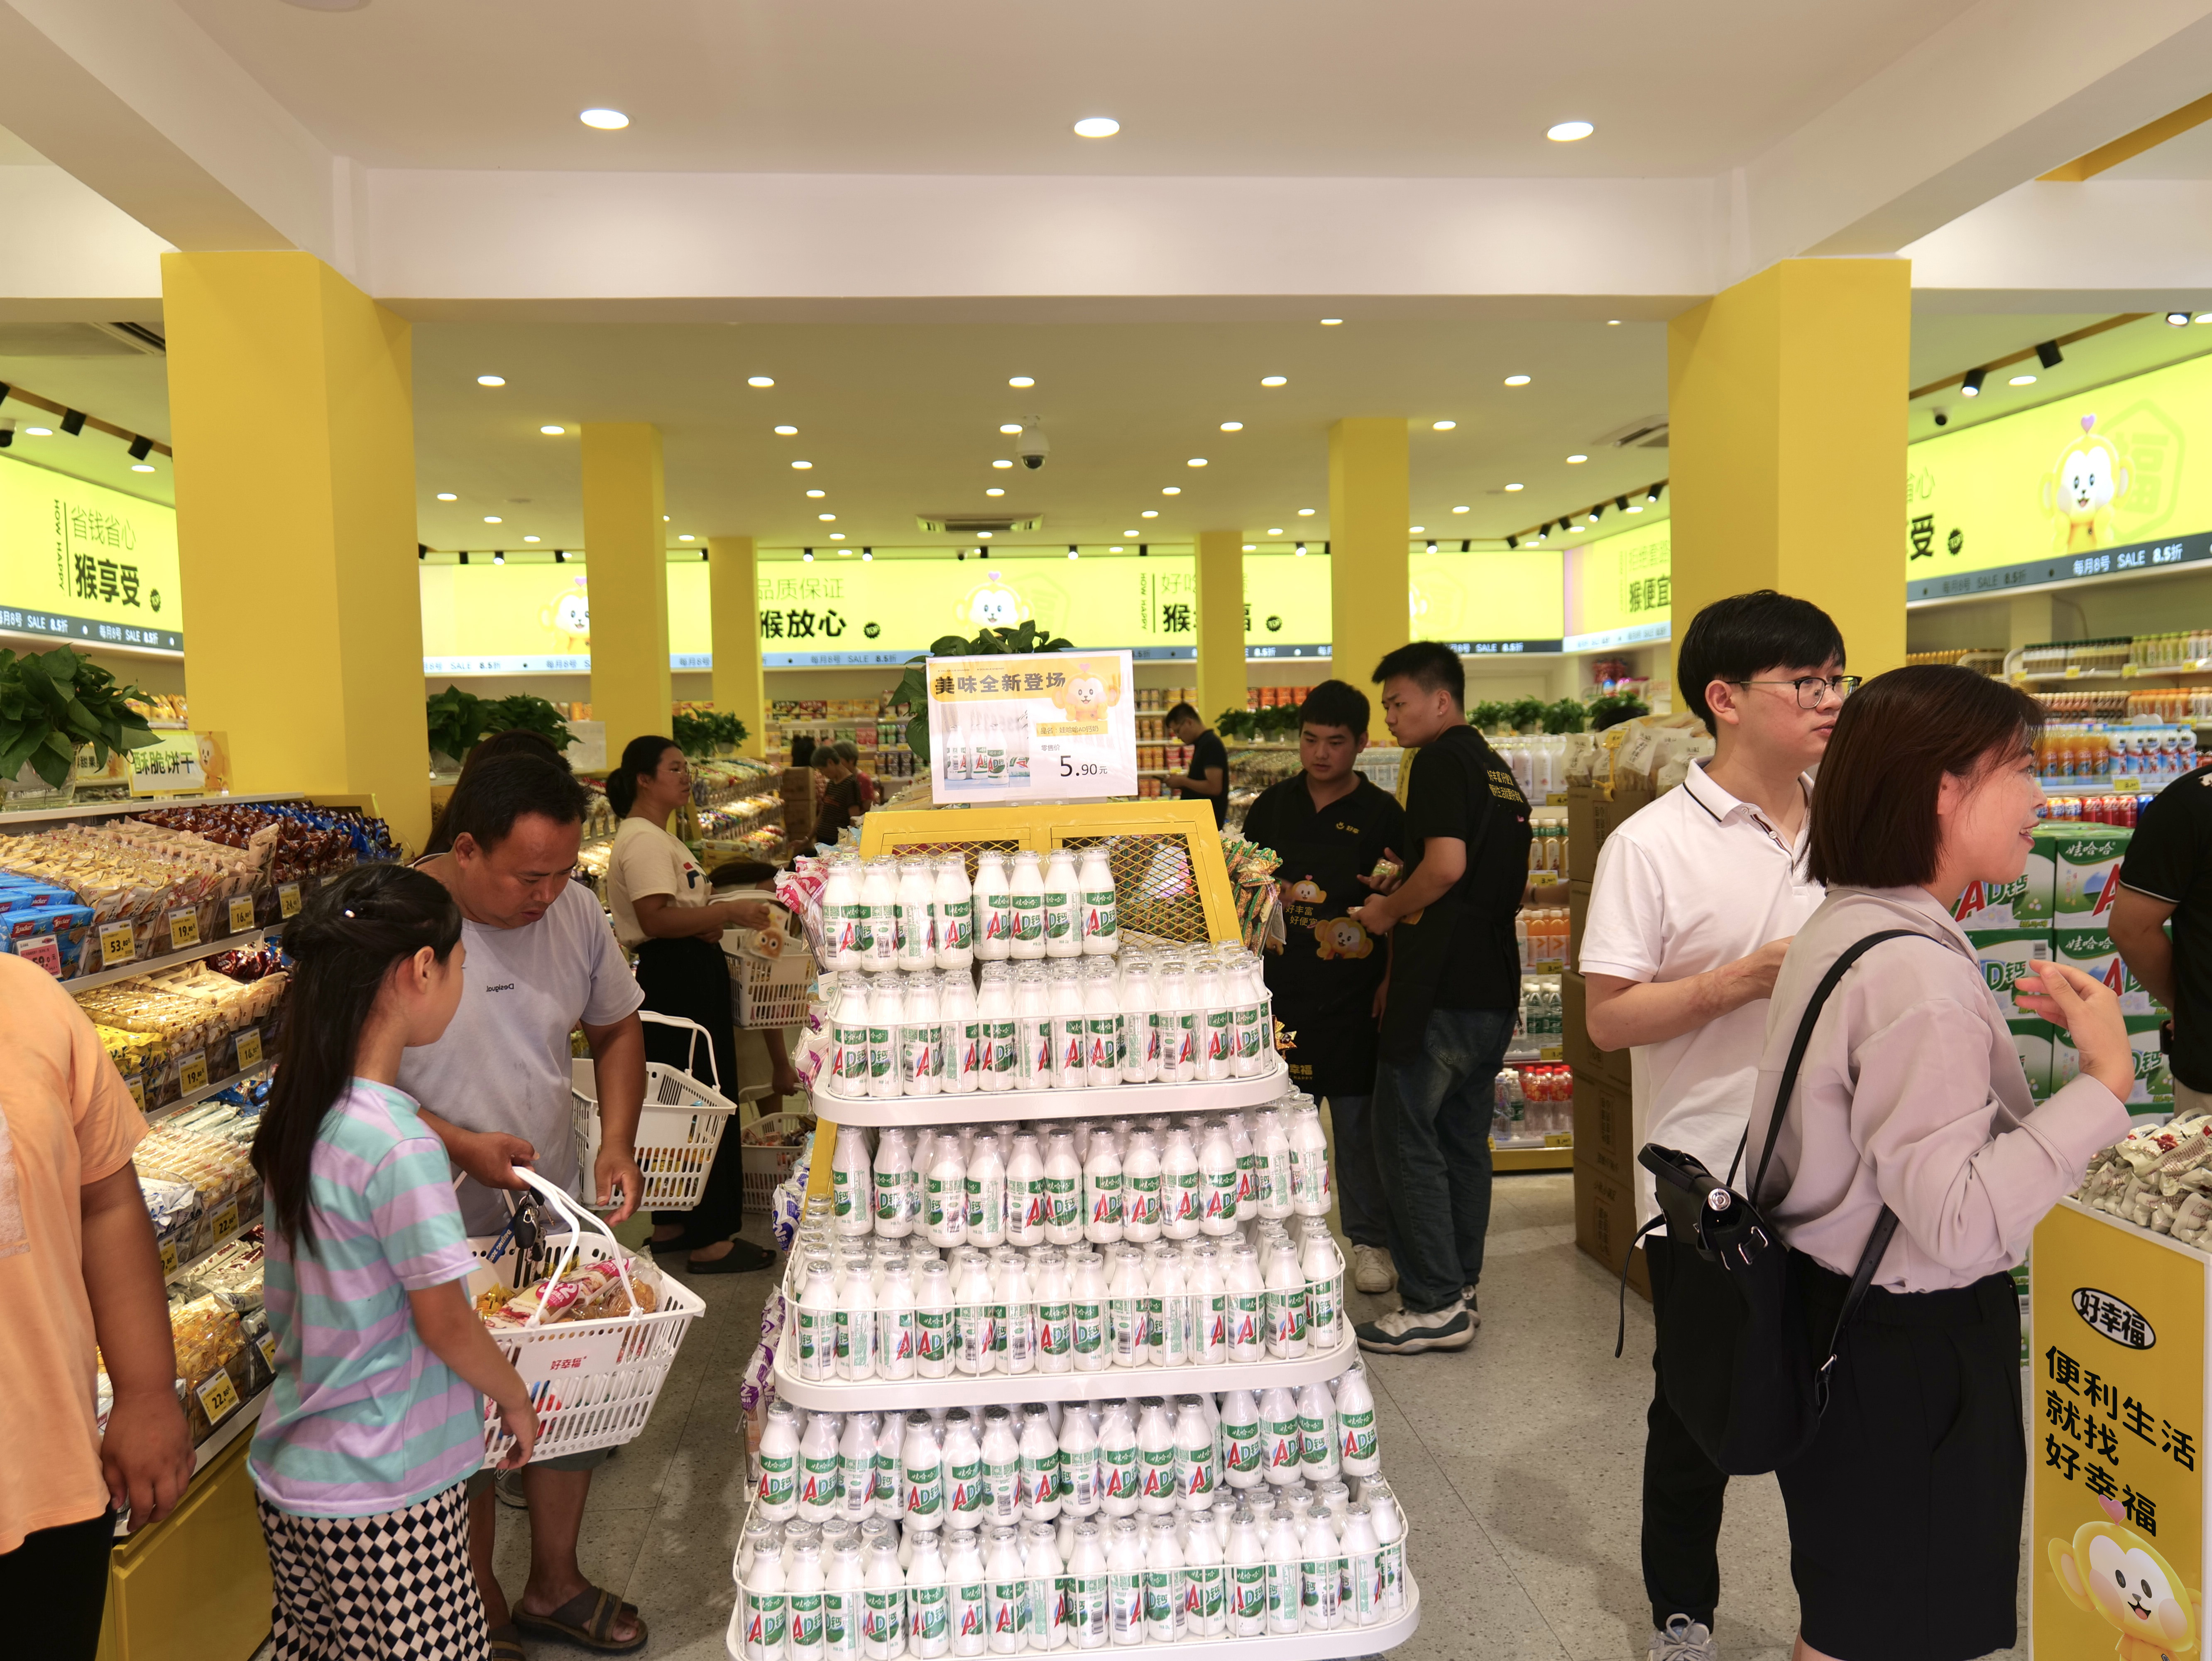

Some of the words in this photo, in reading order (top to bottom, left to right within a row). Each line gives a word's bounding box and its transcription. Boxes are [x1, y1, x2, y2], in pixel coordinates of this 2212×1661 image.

[71, 505, 136, 550] 省钱省心
[2073, 556, 2110, 576] 每月8号
[2117, 550, 2145, 568] SALE
[2153, 544, 2183, 565] 8.5折
[74, 553, 140, 608] 猴享受
[758, 578, 844, 600] 品质保证
[1977, 575, 1998, 589] SALE
[1630, 573, 1671, 613] 猴便宜
[27, 615, 46, 630] SALE
[50, 618, 69, 634] 8.5折
[125, 630, 141, 642] SALE
[848, 654, 869, 664] SALE
[876, 654, 897, 663] 8.5折
[1476, 643, 1498, 653] SALE
[451, 661, 471, 670] SALE
[935, 672, 1066, 695] 美味全新登场
[132, 750, 194, 775] 酥脆饼干
[2065, 840, 2114, 857] 娃哈哈
[1286, 905, 1314, 916] 好丰富
[1290, 916, 1318, 926] 好便宜
[15, 924, 33, 934] Loacker
[54, 917, 71, 927] Loacker
[987, 911, 1009, 940] AD
[1011, 912, 1040, 940] AD钙
[2066, 935, 2114, 951] 娃哈哈
[2078, 1289, 2145, 1346] 好幸福
[550, 1357, 583, 1370] 好幸福
[2045, 1345, 2195, 1472] 便利生活
[1232, 1426, 1255, 1436] 娃哈哈
[2046, 1389, 2119, 1466] 就找
[1344, 1431, 1375, 1457] AD钙
[763, 1460, 788, 1470] 娃哈哈
[1227, 1442, 1259, 1469] AD钙
[759, 1473, 792, 1498] AD钙
[912, 1471, 935, 1481] 娃哈哈
[2046, 1437, 2156, 1537] 好幸福
[908, 1486, 940, 1512] AD钙
